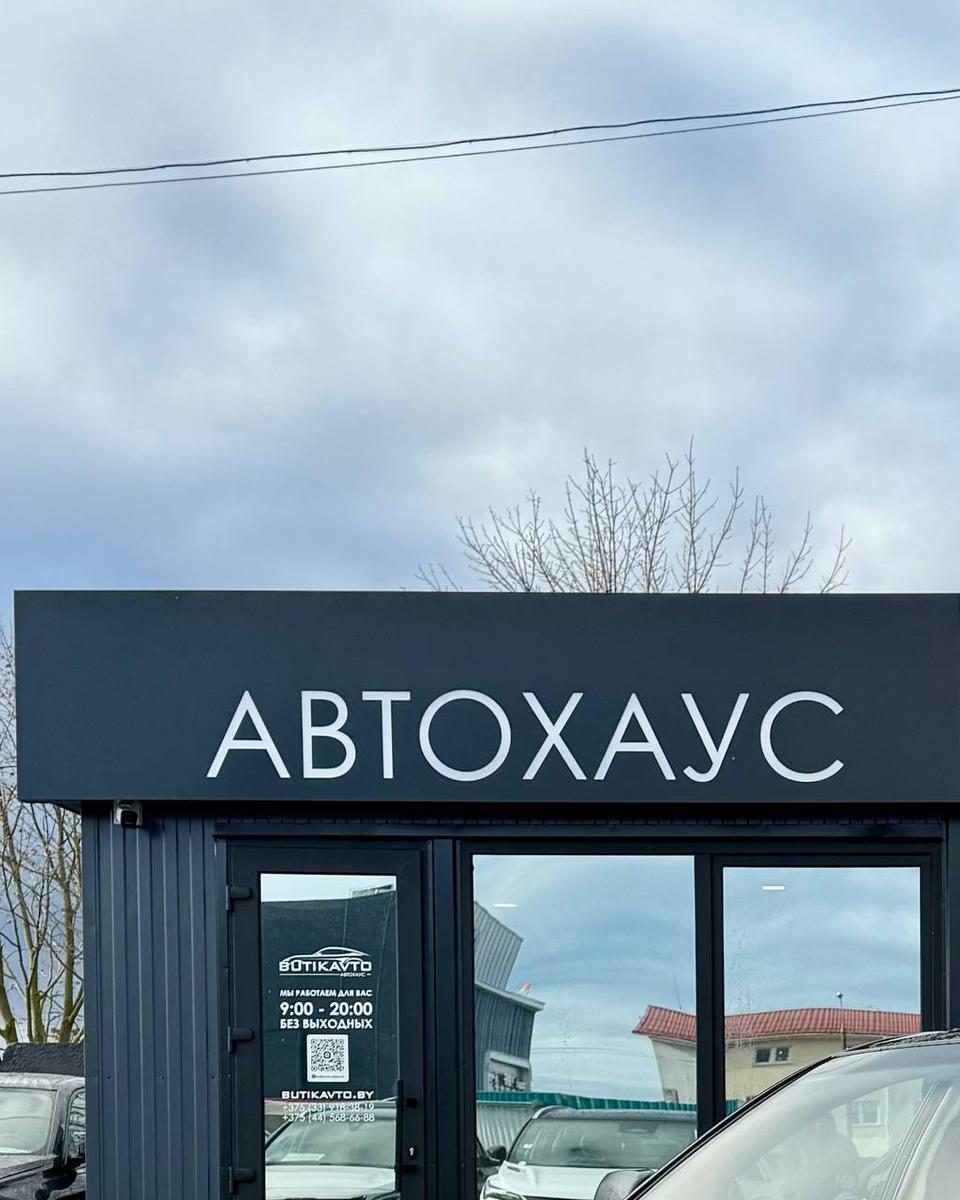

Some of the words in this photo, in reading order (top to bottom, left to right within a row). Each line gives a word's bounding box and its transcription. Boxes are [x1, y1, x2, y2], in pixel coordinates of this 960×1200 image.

[206, 689, 845, 783] АВТОХАУС
[279, 960, 372, 972] BUTIKAVTO
[280, 989, 294, 997] МЫ
[295, 989, 337, 997] РАБОТАЕМ
[337, 989, 354, 997] ДЛЯ
[355, 989, 373, 997] ВАС
[279, 1001, 314, 1016] 9:00
[329, 1001, 373, 1016] 20:00
[280, 1018, 300, 1029] БЕЗ
[302, 1018, 373, 1030] ВЫХОДНЫХ
[281, 1090, 374, 1099] BUTIKAVTO.BY
[282, 1102, 306, 1112] +375
[282, 1112, 306, 1122] +375
[308, 1112, 326, 1124] (44)
[329, 1112, 375, 1122] 568-66-88
